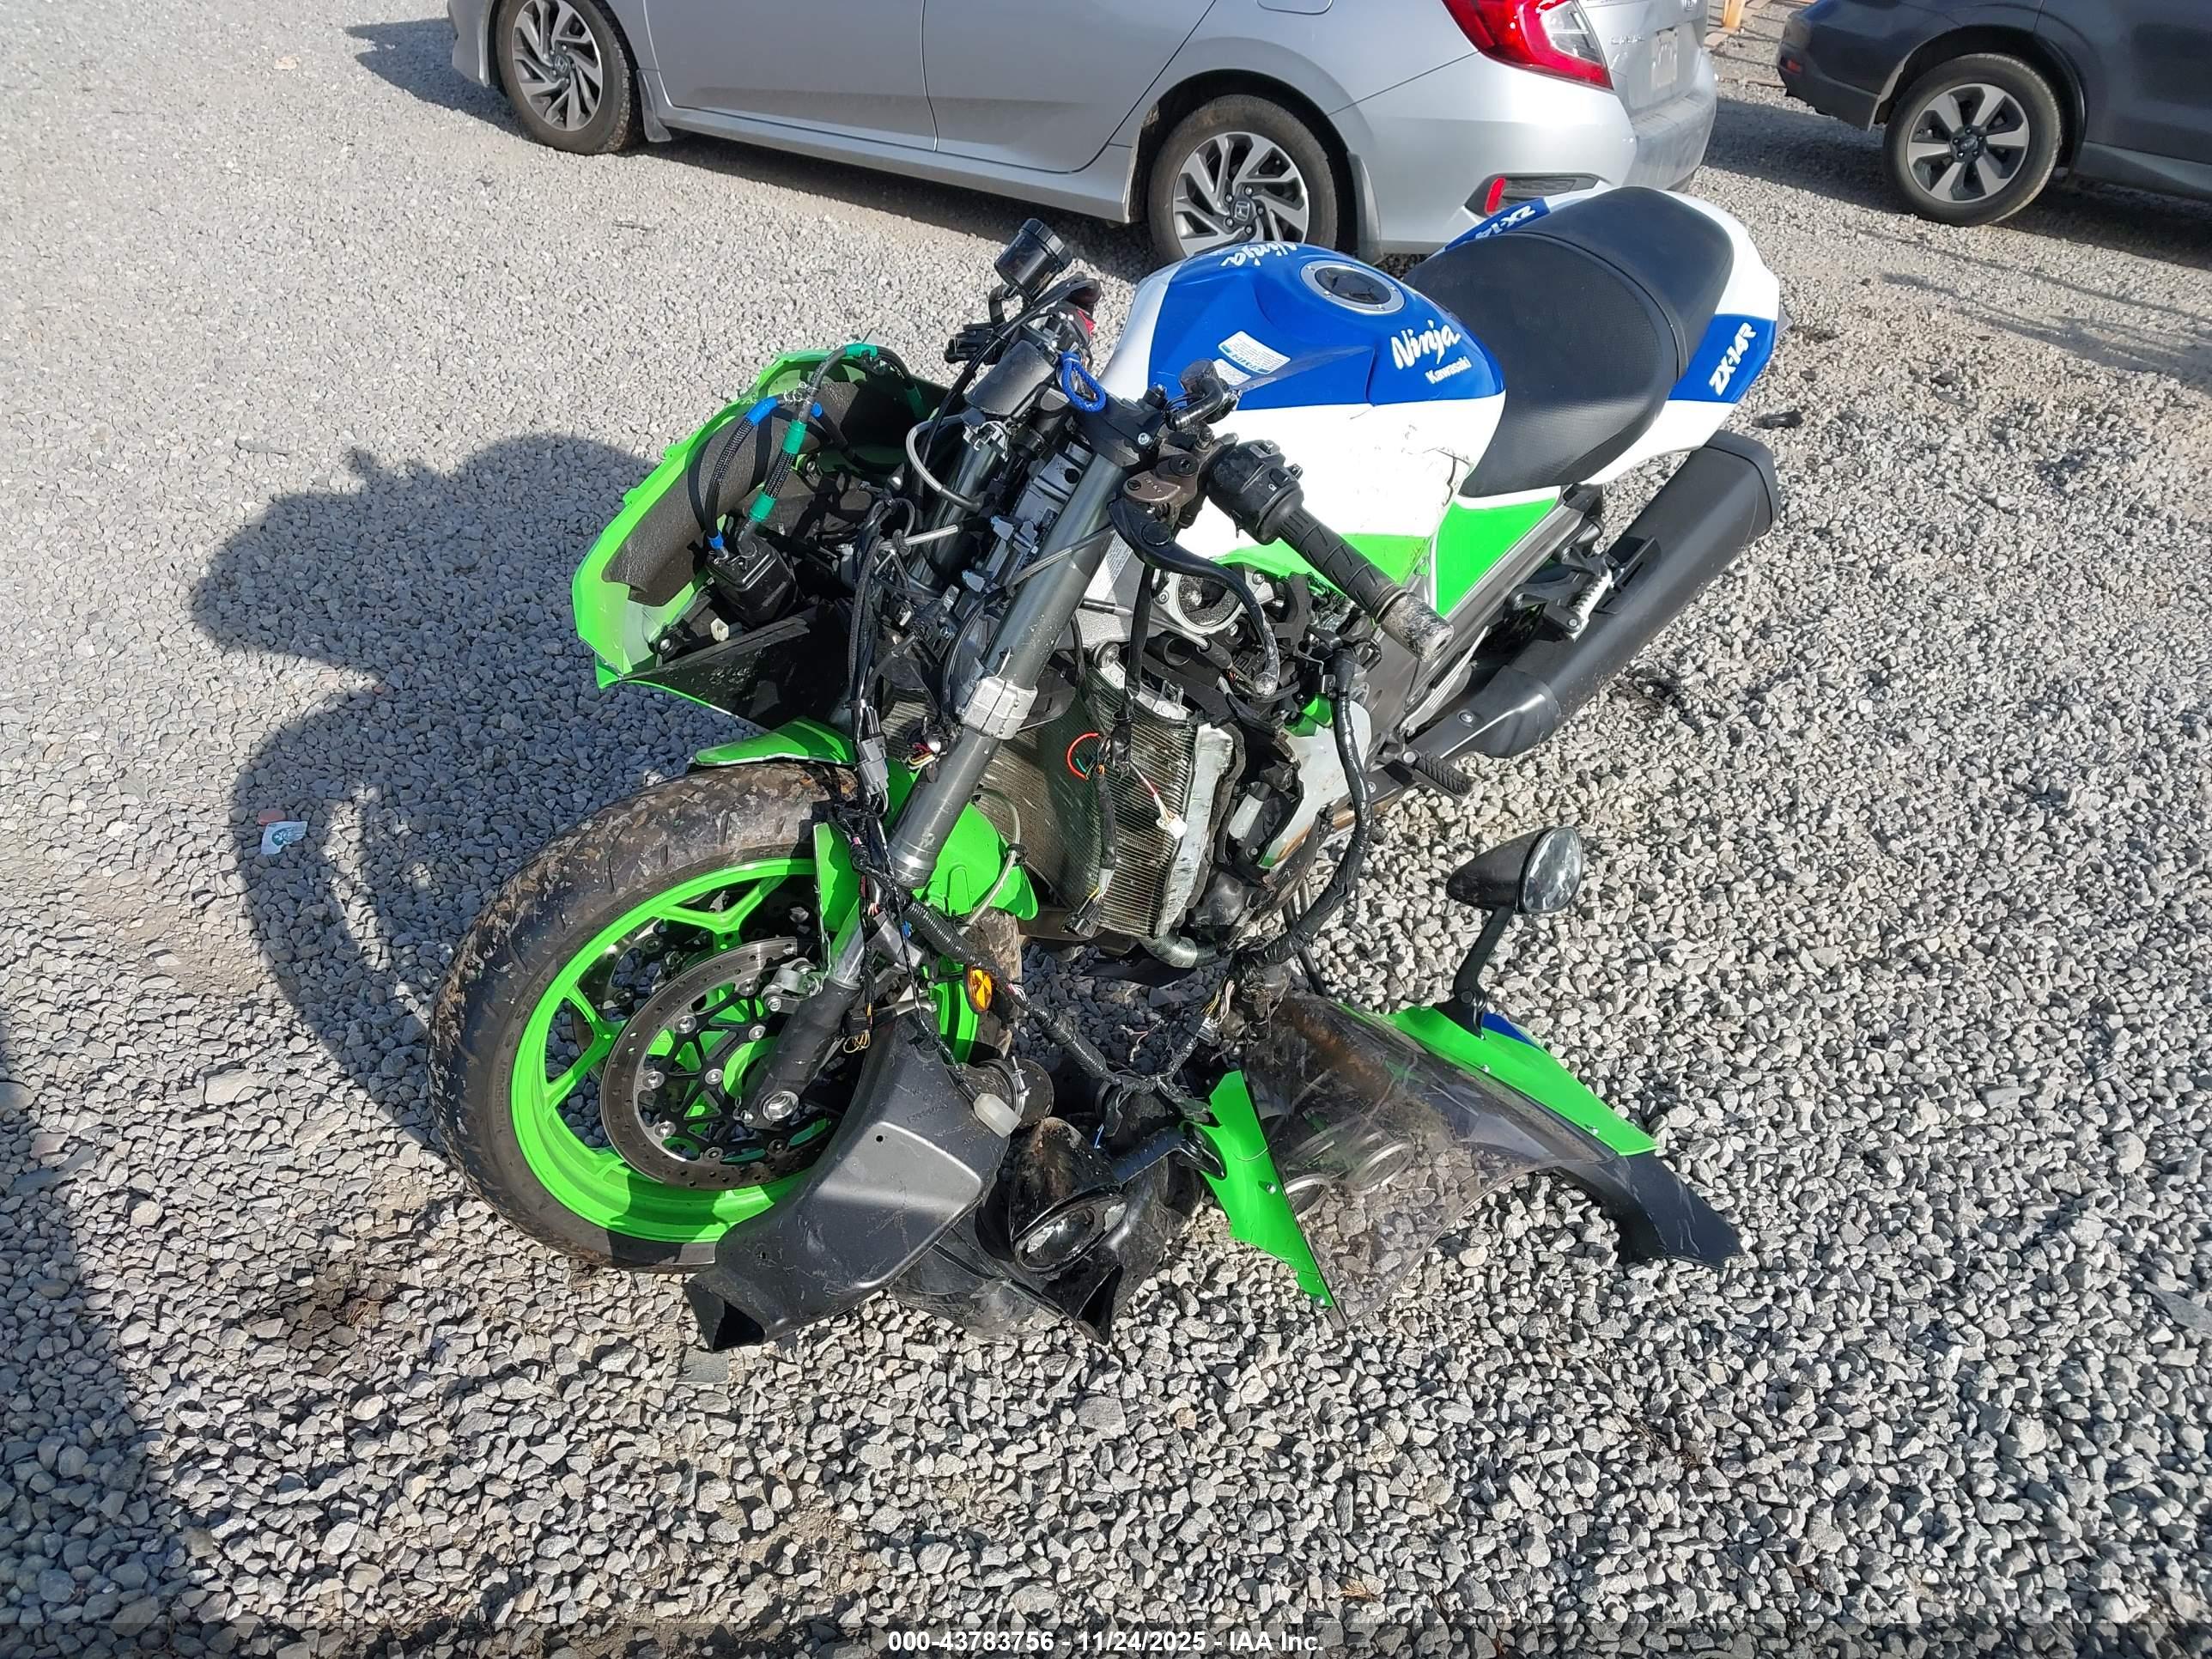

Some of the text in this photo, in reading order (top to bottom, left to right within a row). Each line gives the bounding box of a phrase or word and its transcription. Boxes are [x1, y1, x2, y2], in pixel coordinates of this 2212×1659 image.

[1219, 242, 1297, 267] Ninja
[1390, 319, 1462, 370] Ninja
[1708, 322, 1757, 397] ZX-14R
[1425, 356, 1473, 385] Kawasaki
